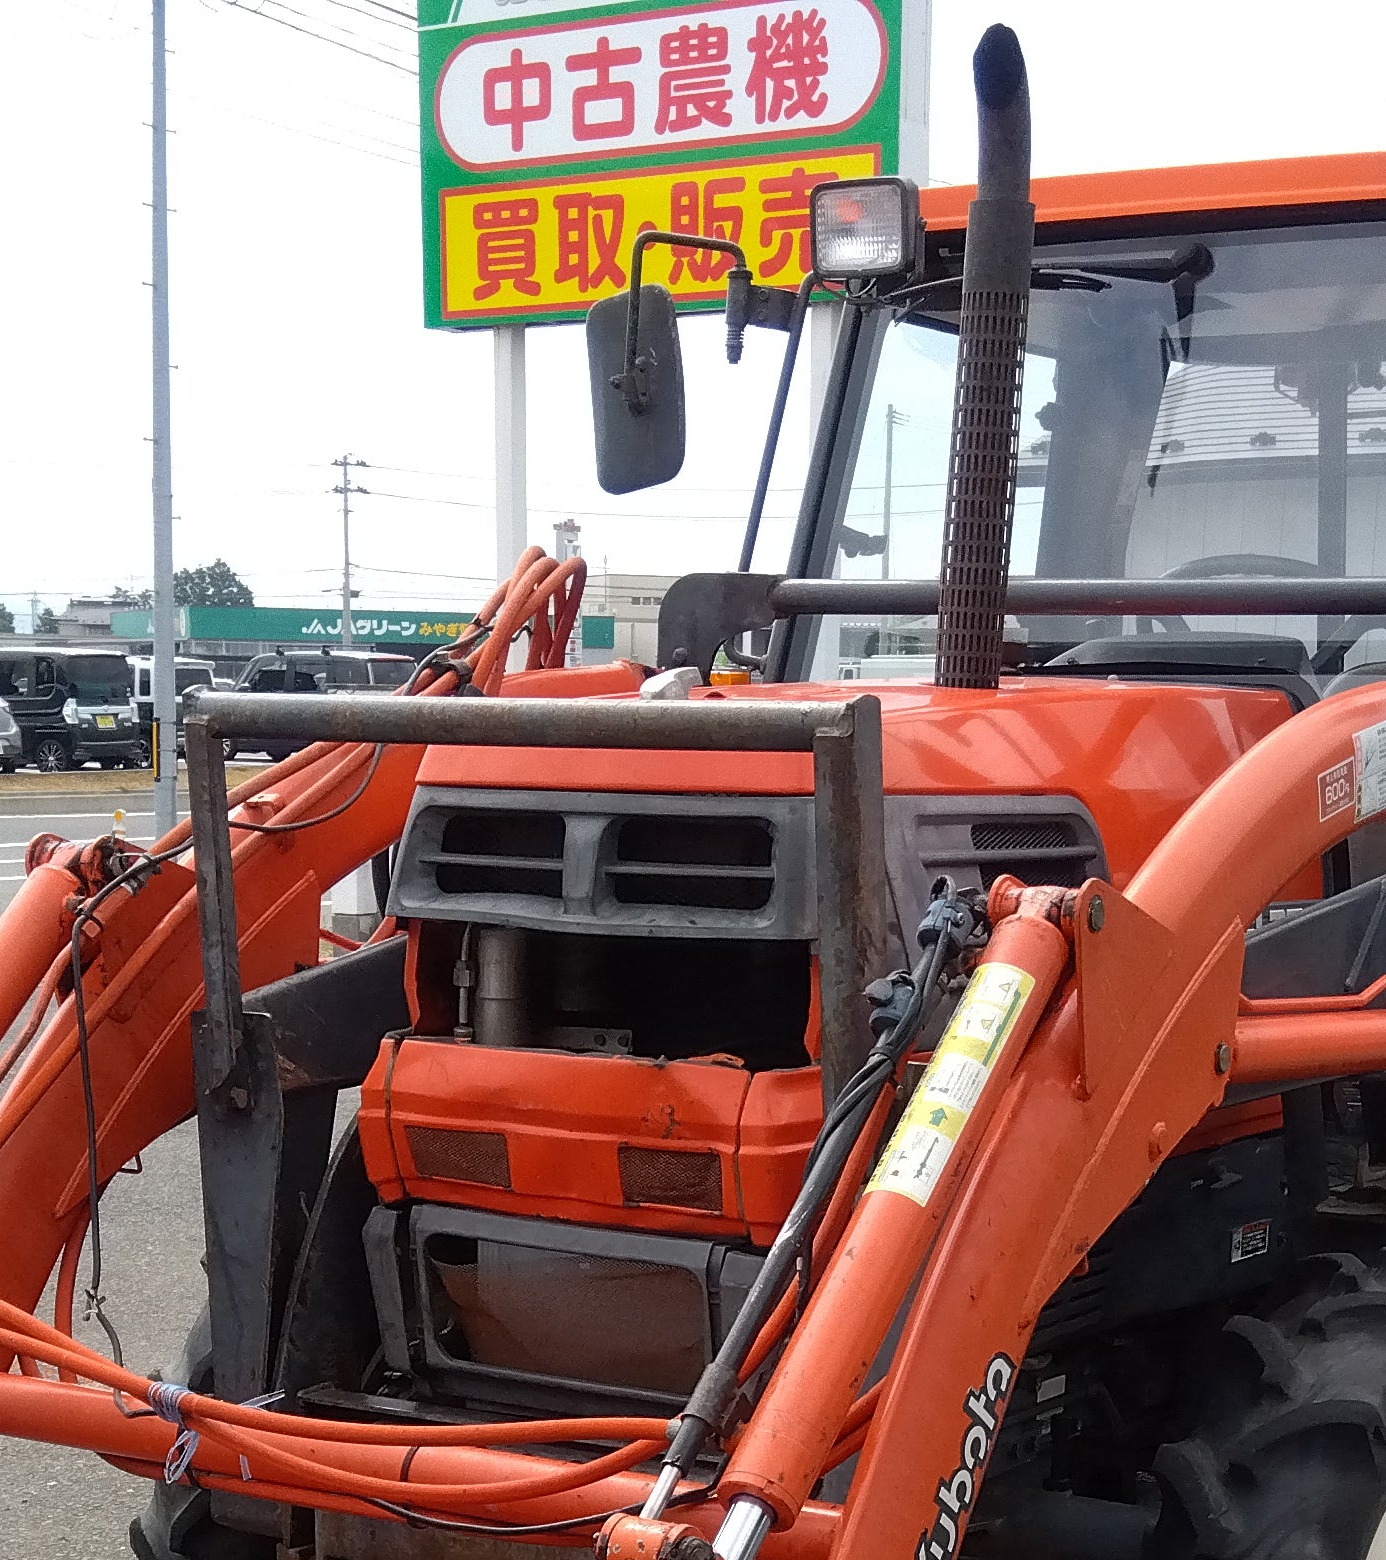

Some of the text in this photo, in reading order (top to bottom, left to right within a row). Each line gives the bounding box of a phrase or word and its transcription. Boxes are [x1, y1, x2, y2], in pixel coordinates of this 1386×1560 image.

[482, 8, 829, 152] 中古農機
[473, 168, 840, 301] 買取・販売
